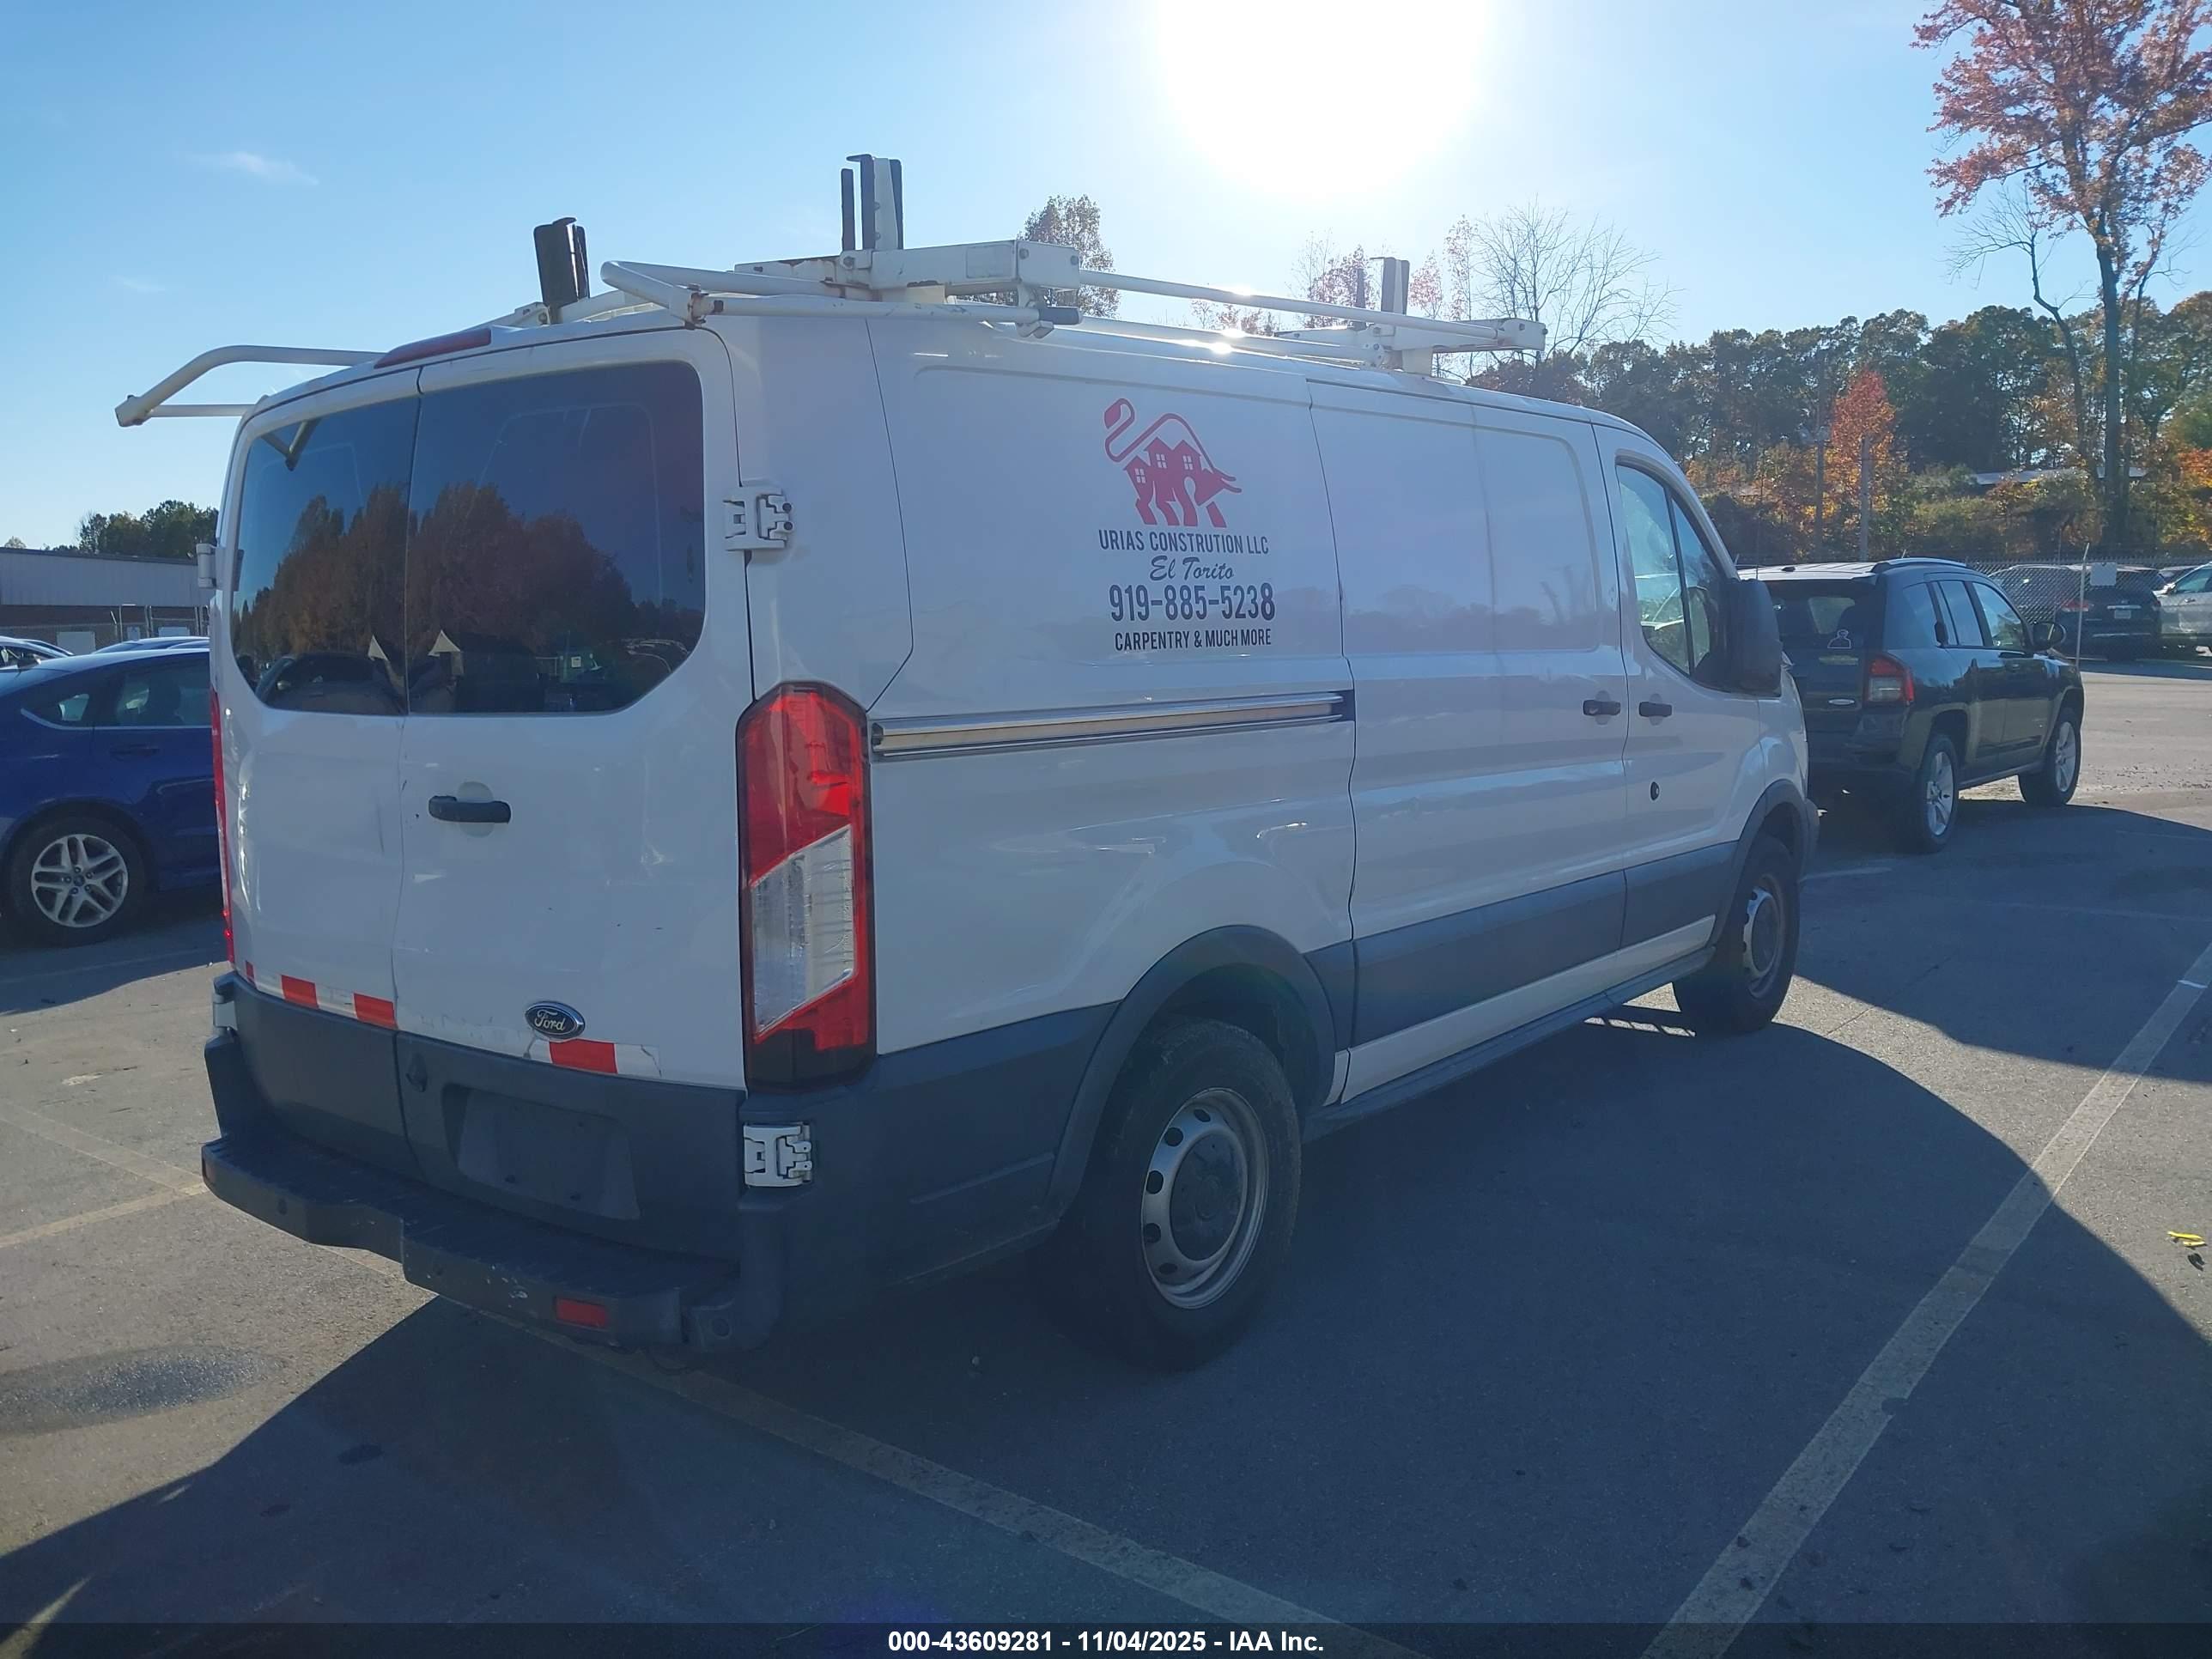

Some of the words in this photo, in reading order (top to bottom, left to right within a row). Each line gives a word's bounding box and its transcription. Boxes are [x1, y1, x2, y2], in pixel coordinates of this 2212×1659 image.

[1098, 530, 1145, 551] URIAS
[1149, 532, 1243, 554] CONSTRUTION
[1246, 535, 1268, 554] LLC
[1149, 555, 1176, 580] El
[1182, 556, 1235, 580] Torito
[1109, 582, 1275, 622] 919-885-5238
[1115, 631, 1189, 651] CARPENTRY
[1194, 631, 1202, 647] &
[1205, 629, 1238, 647] MUCH
[1241, 629, 1272, 646] MORE
[534, 1009, 566, 1031] Ford
